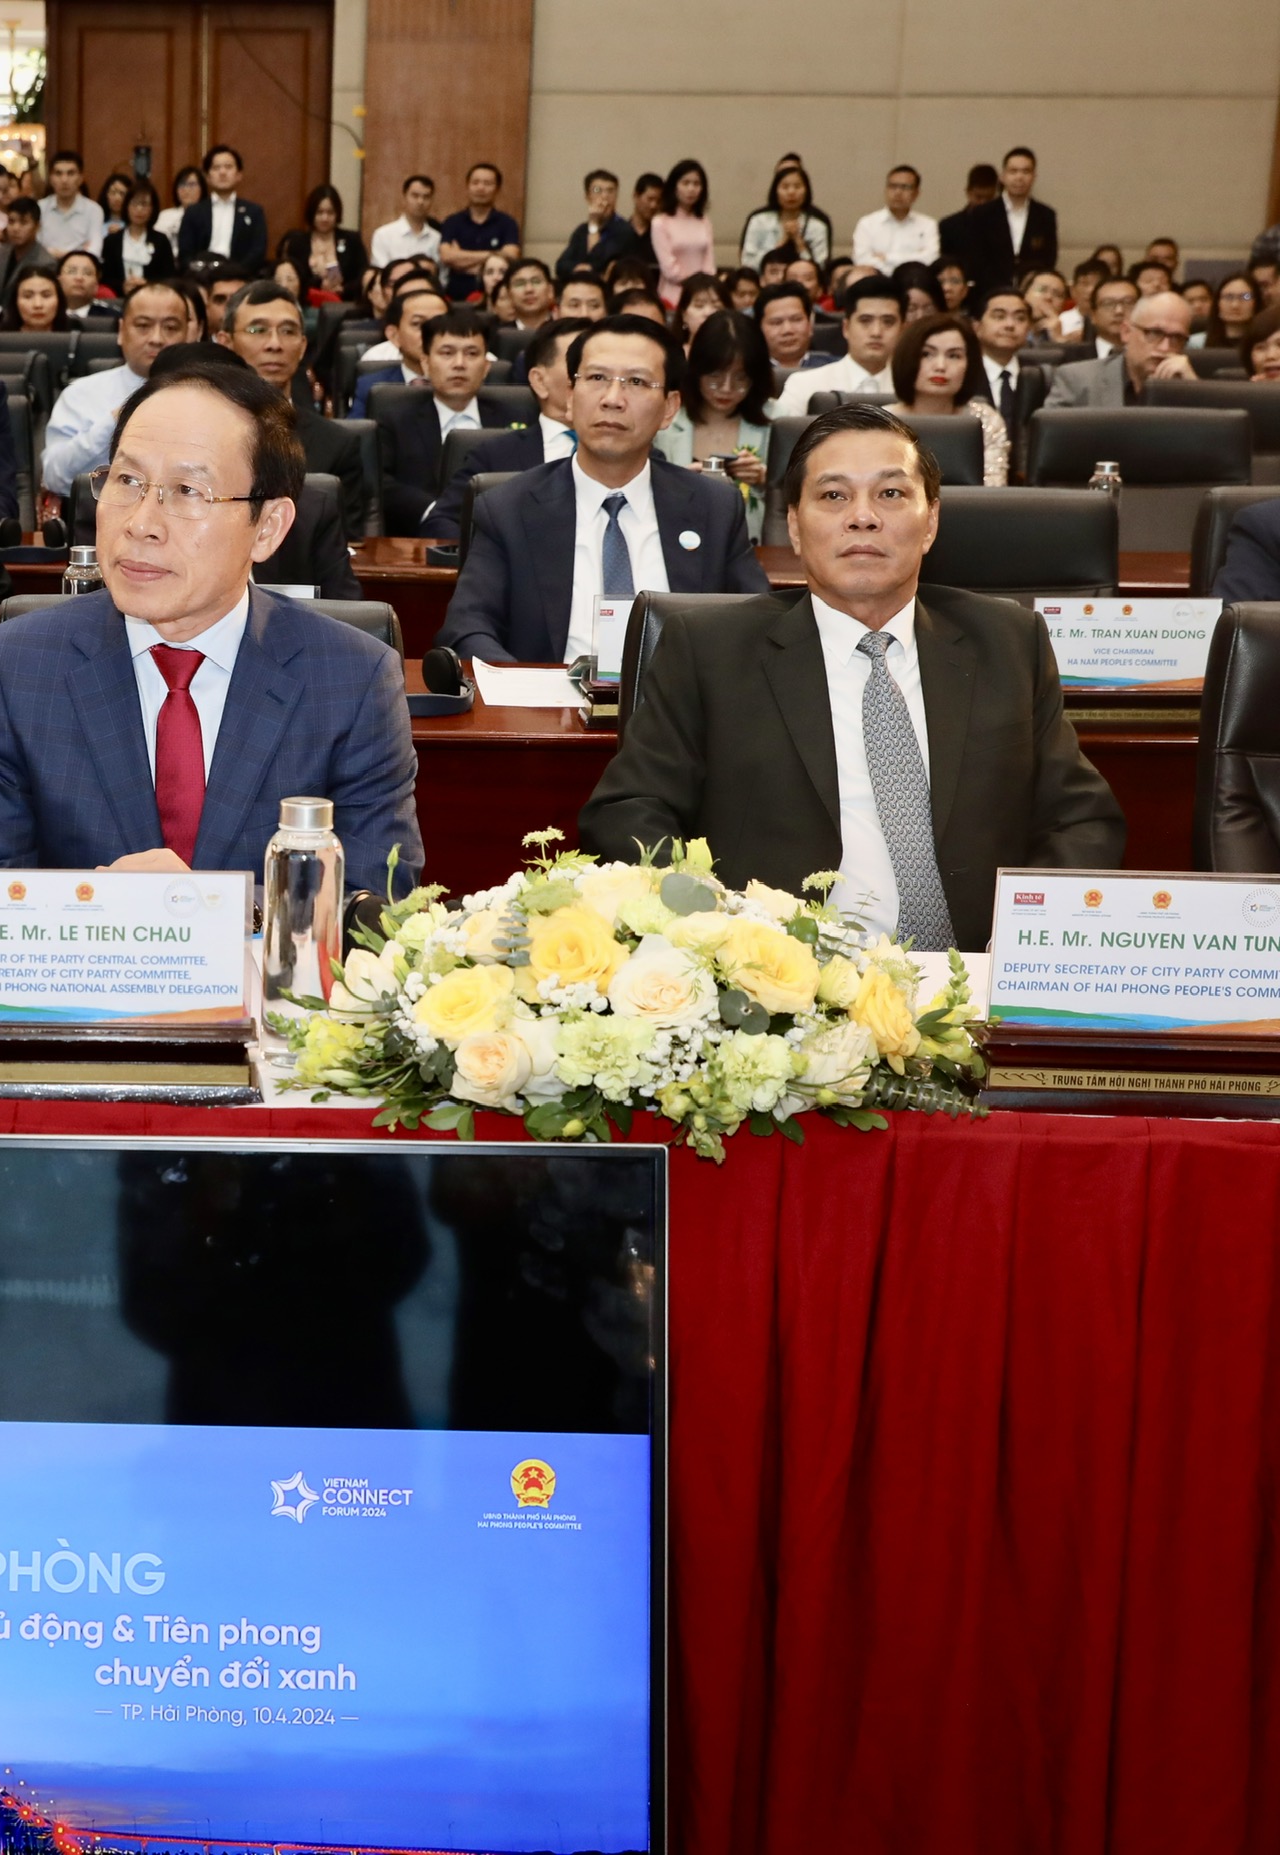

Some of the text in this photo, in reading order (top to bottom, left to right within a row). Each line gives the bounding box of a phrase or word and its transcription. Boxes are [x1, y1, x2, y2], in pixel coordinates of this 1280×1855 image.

[1070, 629, 1087, 638] Mr.
[1091, 629, 1121, 638] TRAN
[1125, 629, 1157, 639] XUAN
[1161, 630, 1206, 639] DUONG
[1100, 658, 1133, 666] PEOPLE'S
[1135, 659, 1178, 667] COMMITTEE
[22, 925, 51, 941] Mr.
[60, 925, 78, 941] LE
[85, 926, 125, 942] TIEN
[133, 926, 191, 942] CHAU
[1019, 930, 1054, 946] H.E.
[1063, 931, 1092, 947] Mr.
[1101, 932, 1185, 949] NGUYEN
[1193, 934, 1237, 951] VAN
[10, 954, 25, 964] OF
[28, 954, 48, 964] THE
[51, 955, 85, 964] PARTY
[88, 955, 138, 965] CENTRAL
[140, 956, 208, 966] COMMITTEE,
[41, 969, 56, 978] OF
[59, 969, 84, 978] CITY
[87, 969, 122, 979] PARTY
[124, 970, 192, 980] COMMITTEE,
[1004, 963, 1280, 980] DEPUTY SECRETARY OF CITY PARTY COMMI
[5, 983, 47, 992] PHONG
[51, 983, 107, 993] NATIONAL
[110, 984, 166, 994] ASSEMBLY
[169, 984, 238, 995] DELEGATION
[998, 981, 1069, 992] CHAIRMAN
[1074, 982, 1091, 992] OF
[1095, 983, 1117, 993] HAI
[1122, 984, 1170, 995] PHONG
[1175, 985, 1232, 997] PEOPLE'S
[1052, 1075, 1083, 1086] TRUNG
[1086, 1074, 1106, 1086] TÂM
[1109, 1075, 1125, 1090] HỘI
[1128, 1078, 1150, 1091] NGHỊ
[323, 1478, 368, 1488] VIETNAM
[322, 1488, 413, 1505] CONNECT
[322, 1506, 386, 1517] FORUM 2024
[544, 1522, 582, 1530] COMMITTEE
[19, 1612, 103, 1648] động
[112, 1615, 135, 1642] &
[143, 1615, 208, 1644] Tiên
[219, 1617, 320, 1654] phong
[95, 1654, 355, 1692] chuyển đổi xanh
[120, 1704, 335, 1727] TP. Hải Phòng, 10.4.2024
